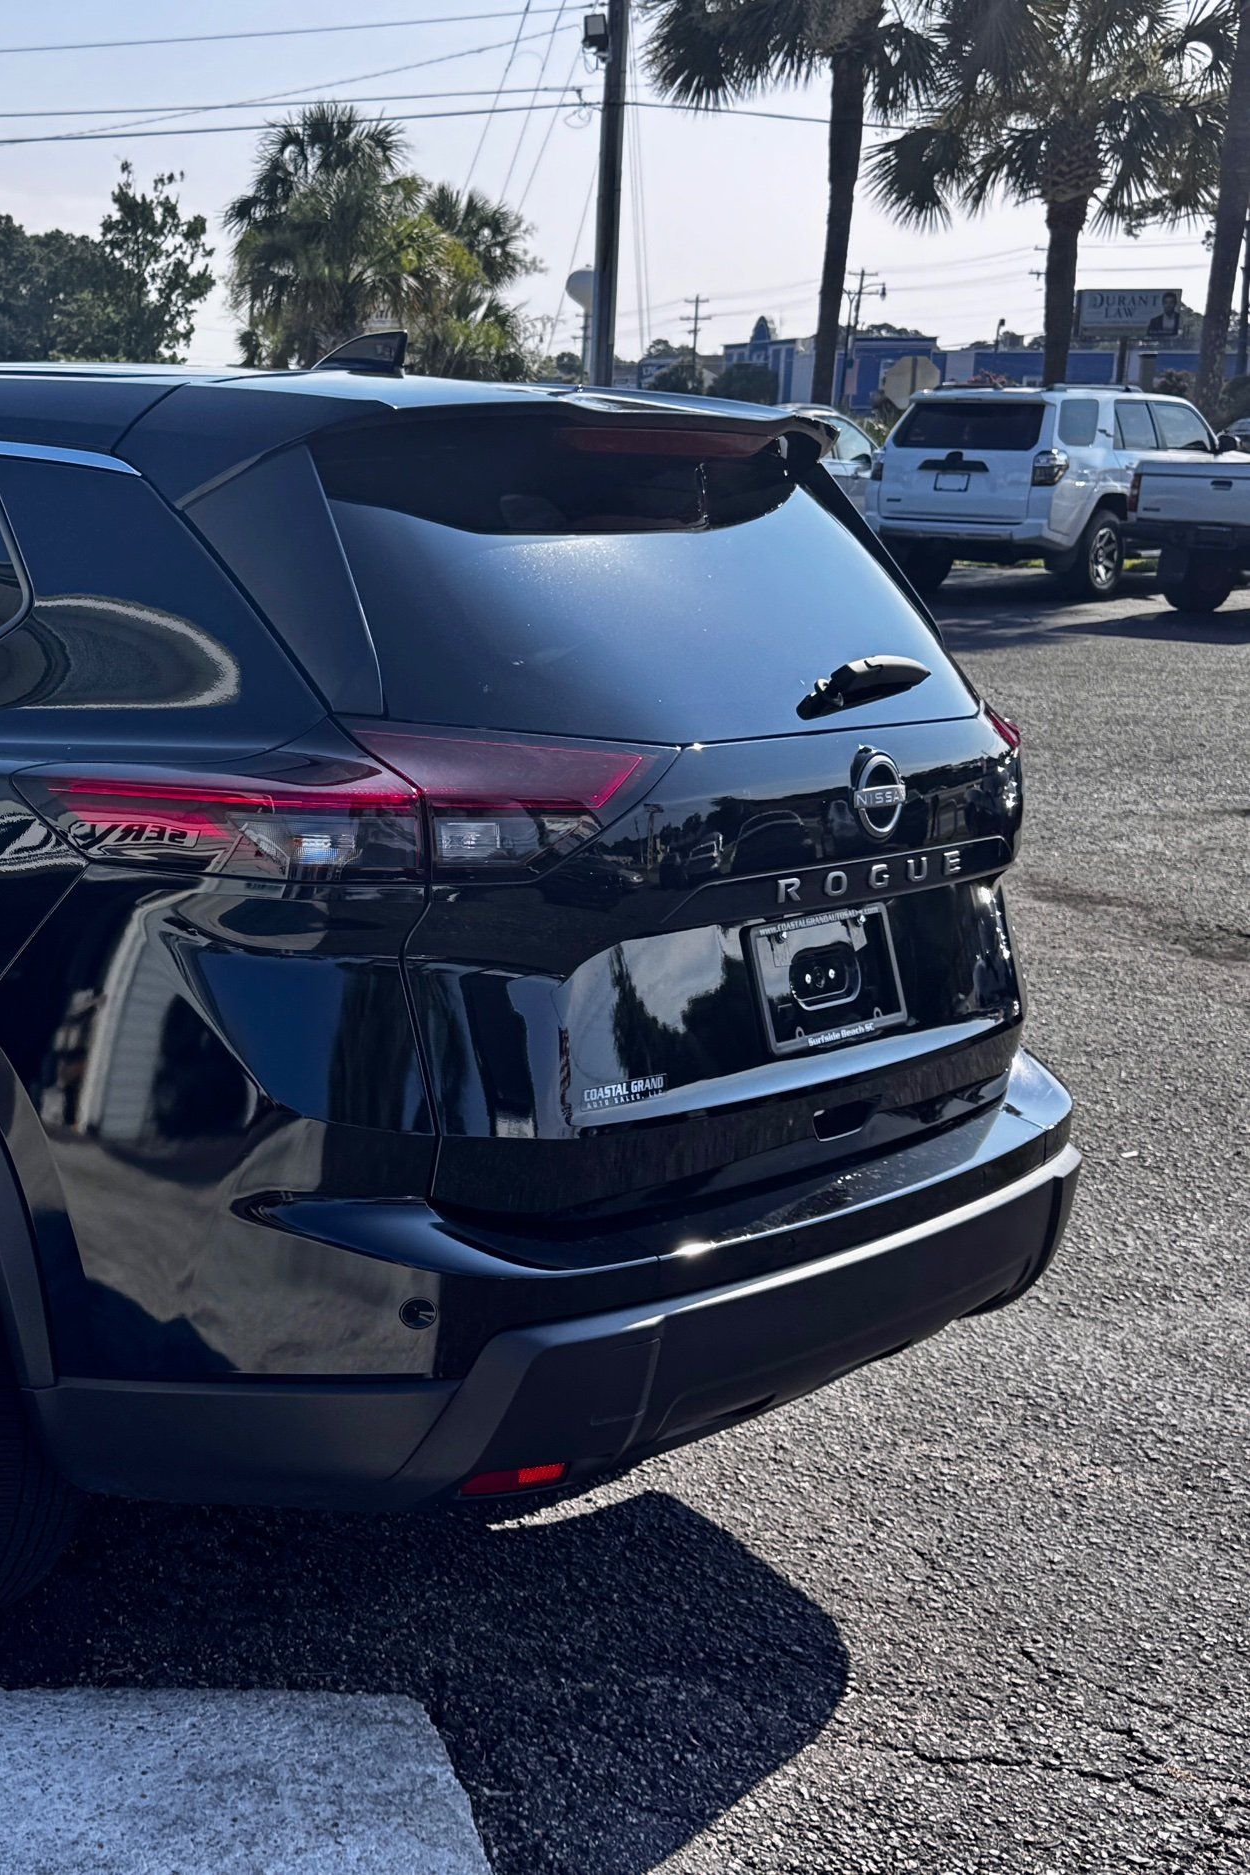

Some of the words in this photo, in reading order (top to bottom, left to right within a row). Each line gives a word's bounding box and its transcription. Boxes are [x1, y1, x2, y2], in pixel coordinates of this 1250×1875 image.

[1092, 292, 1161, 309] DURANT
[1104, 307, 1134, 319] LAW
[777, 850, 961, 903] ROGUE
[808, 1031, 841, 1046] Surfside
[841, 1025, 865, 1038] Beach
[864, 1022, 875, 1032] SC
[584, 1083, 630, 1102] COASTAL
[631, 1076, 664, 1093] GRAND
[586, 1099, 609, 1109] AUTO
